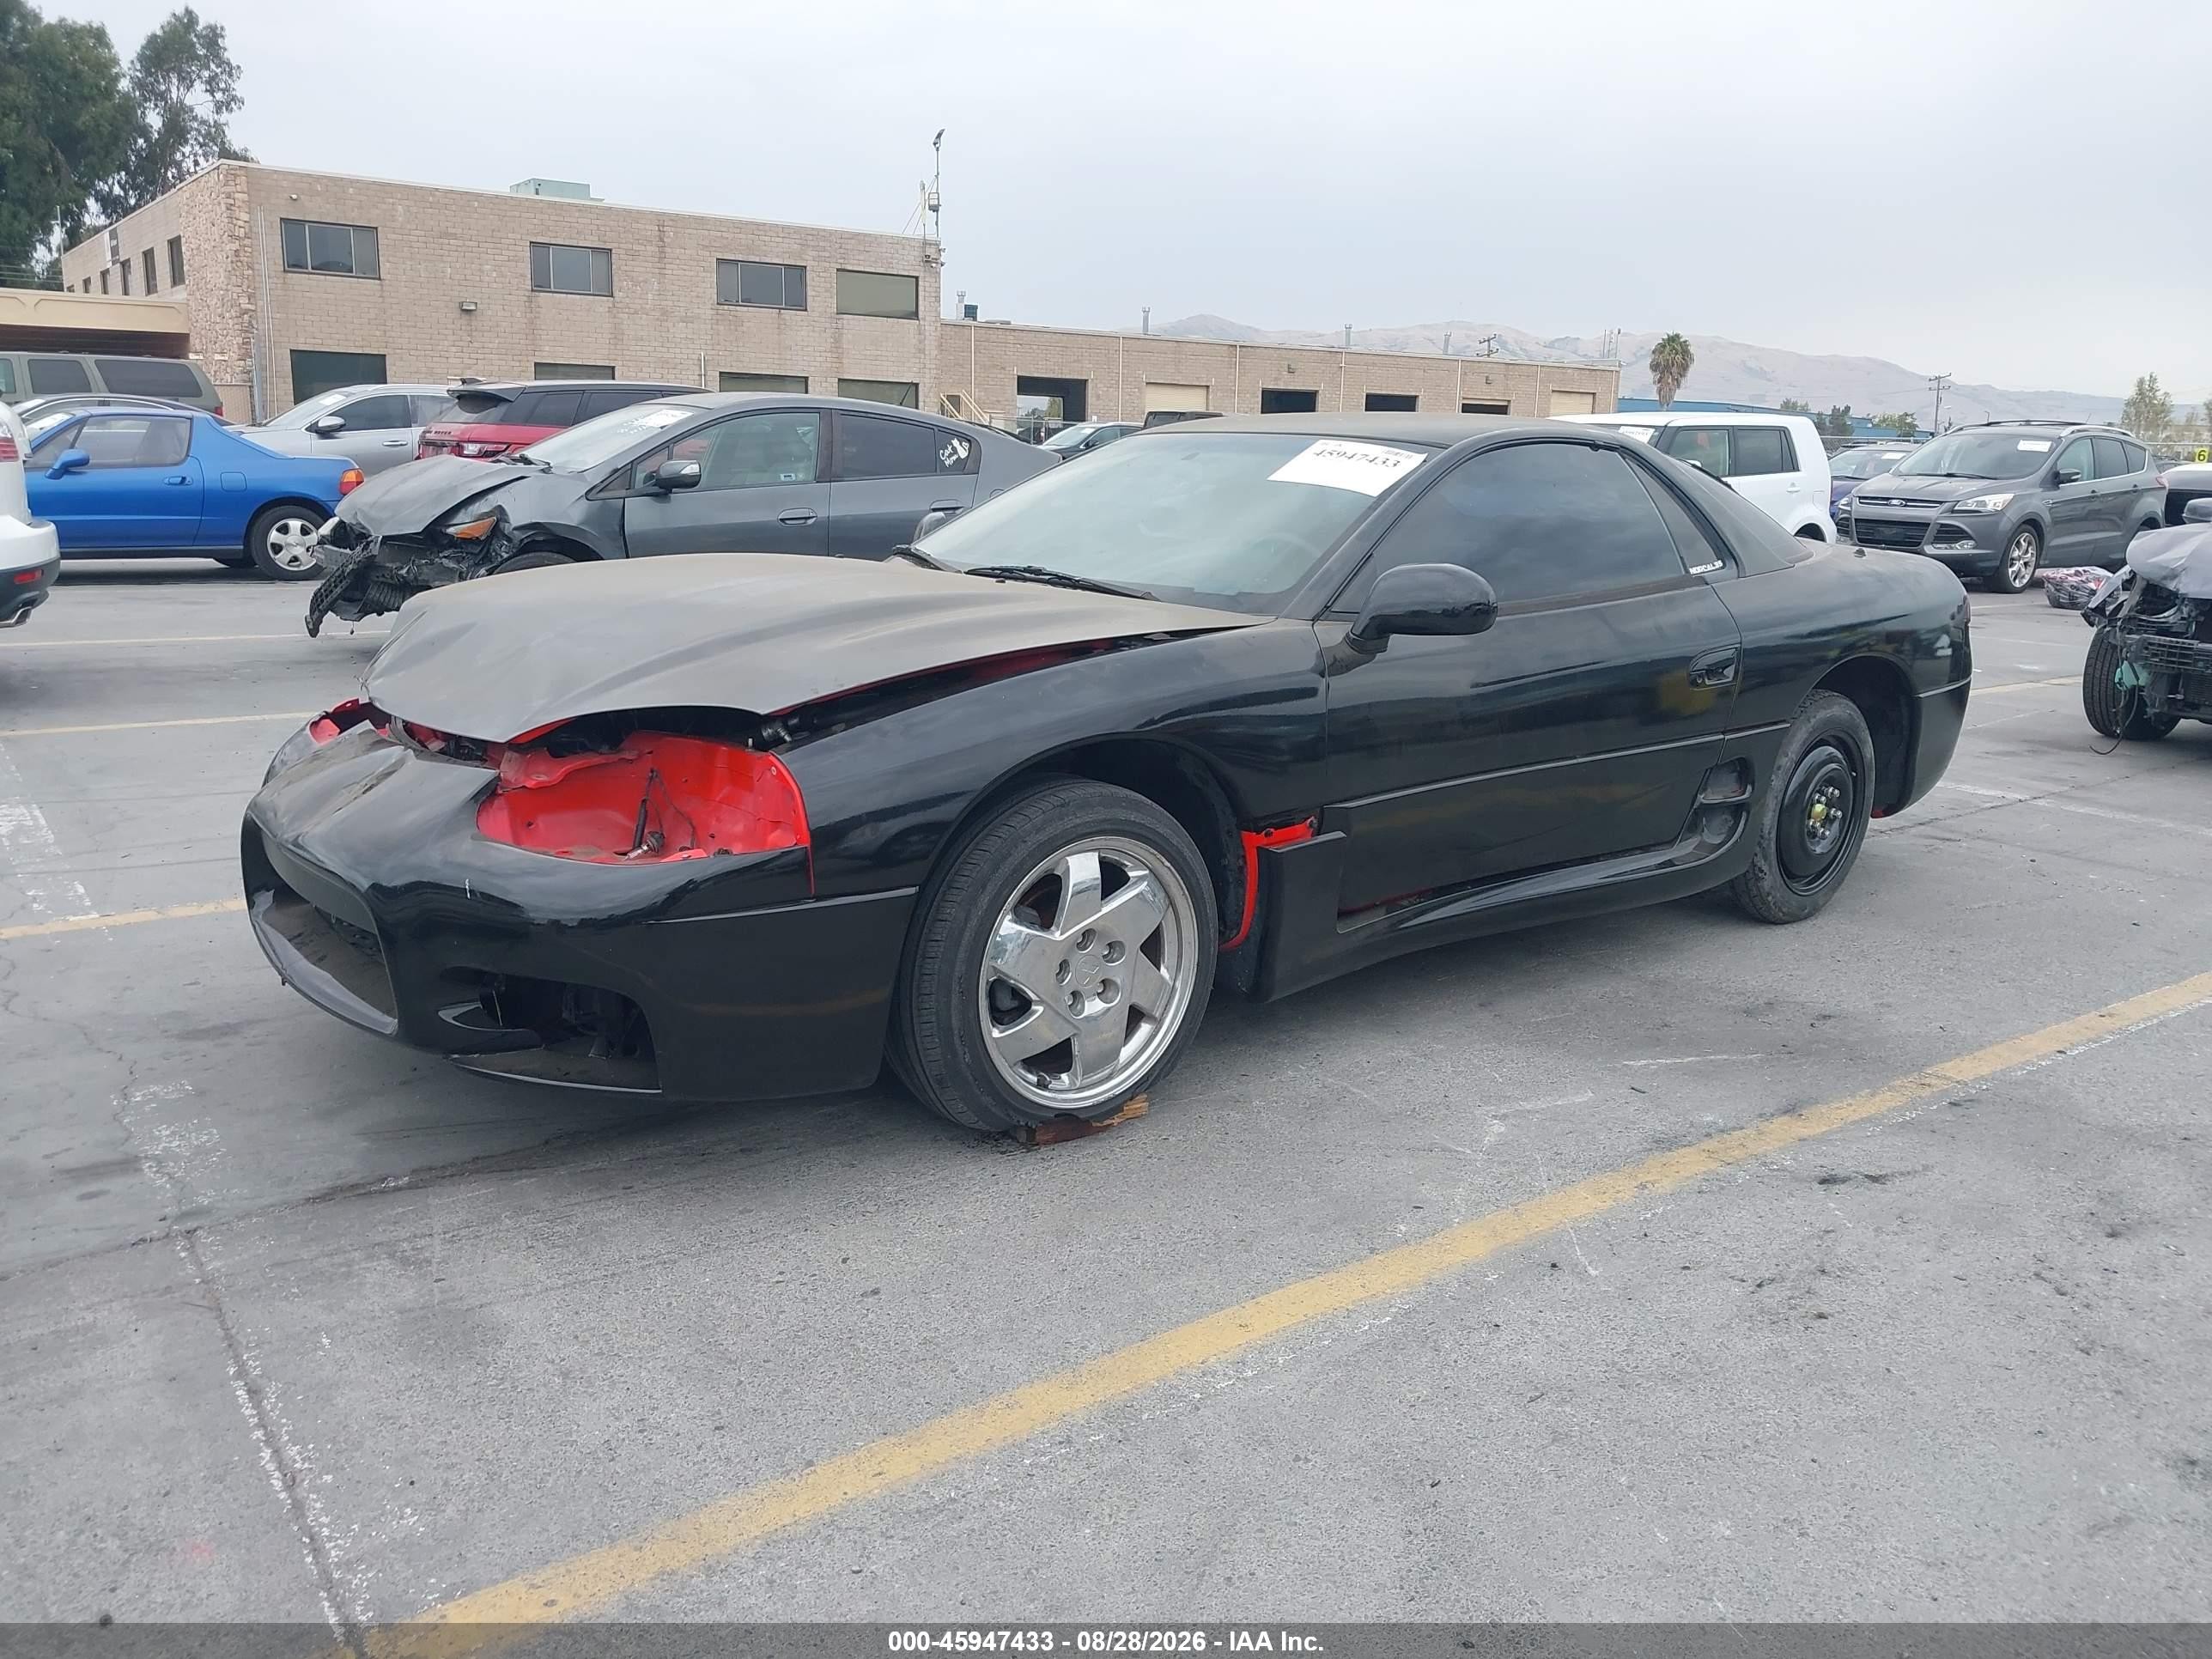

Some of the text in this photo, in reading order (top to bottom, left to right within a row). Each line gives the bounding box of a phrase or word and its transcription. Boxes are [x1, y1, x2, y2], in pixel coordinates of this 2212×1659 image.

[939, 443, 954, 460] Cat
[1313, 448, 1401, 468] 45947433
[2197, 449, 2207, 462] 6
